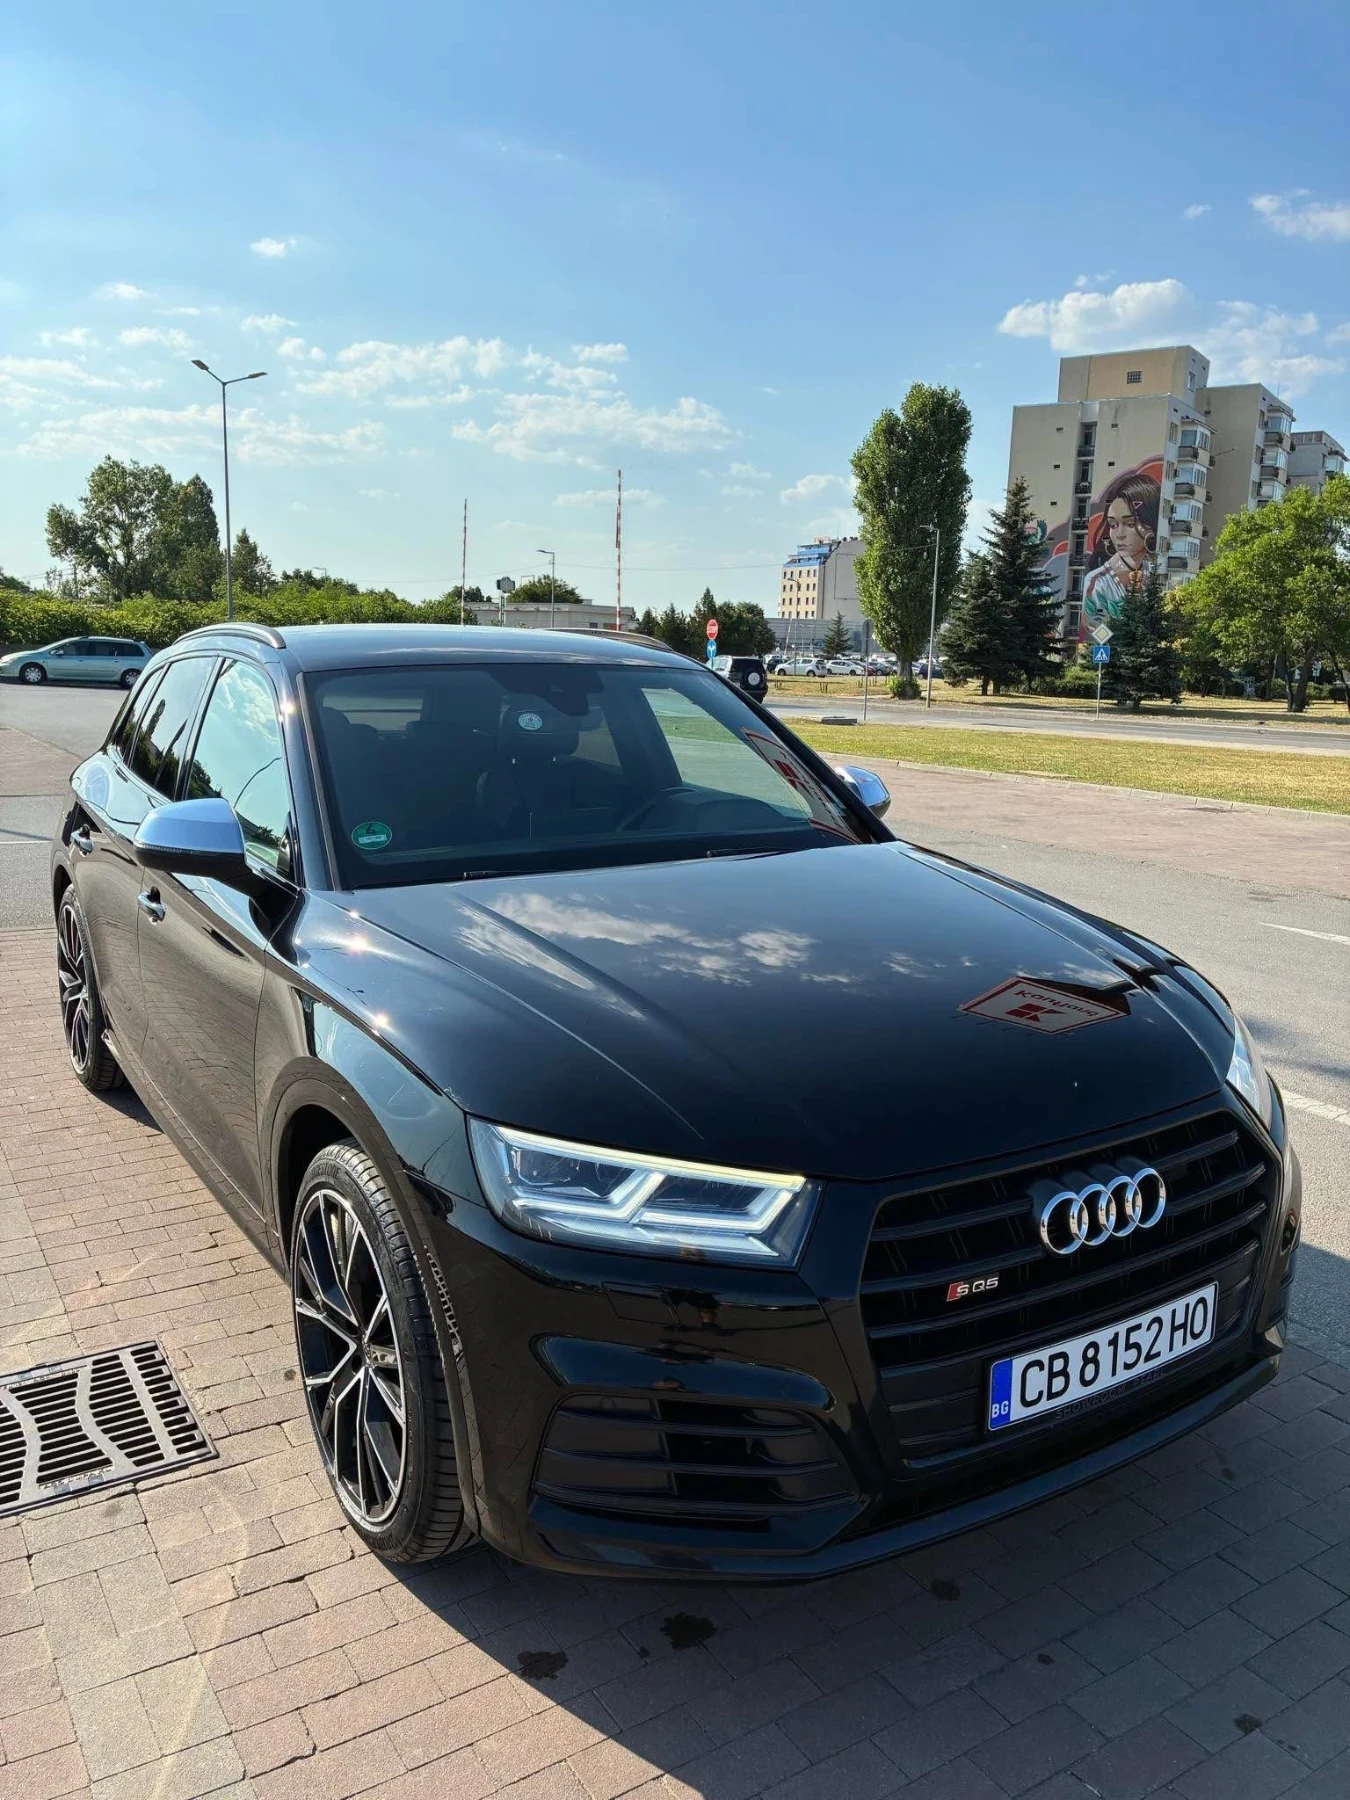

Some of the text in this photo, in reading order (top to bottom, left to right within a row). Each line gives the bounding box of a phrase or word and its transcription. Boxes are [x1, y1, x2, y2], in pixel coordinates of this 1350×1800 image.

[955, 1276, 999, 1297] SQ5
[1019, 1296, 1209, 1408] CB 8152 HO
[991, 1400, 1009, 1419] BG
